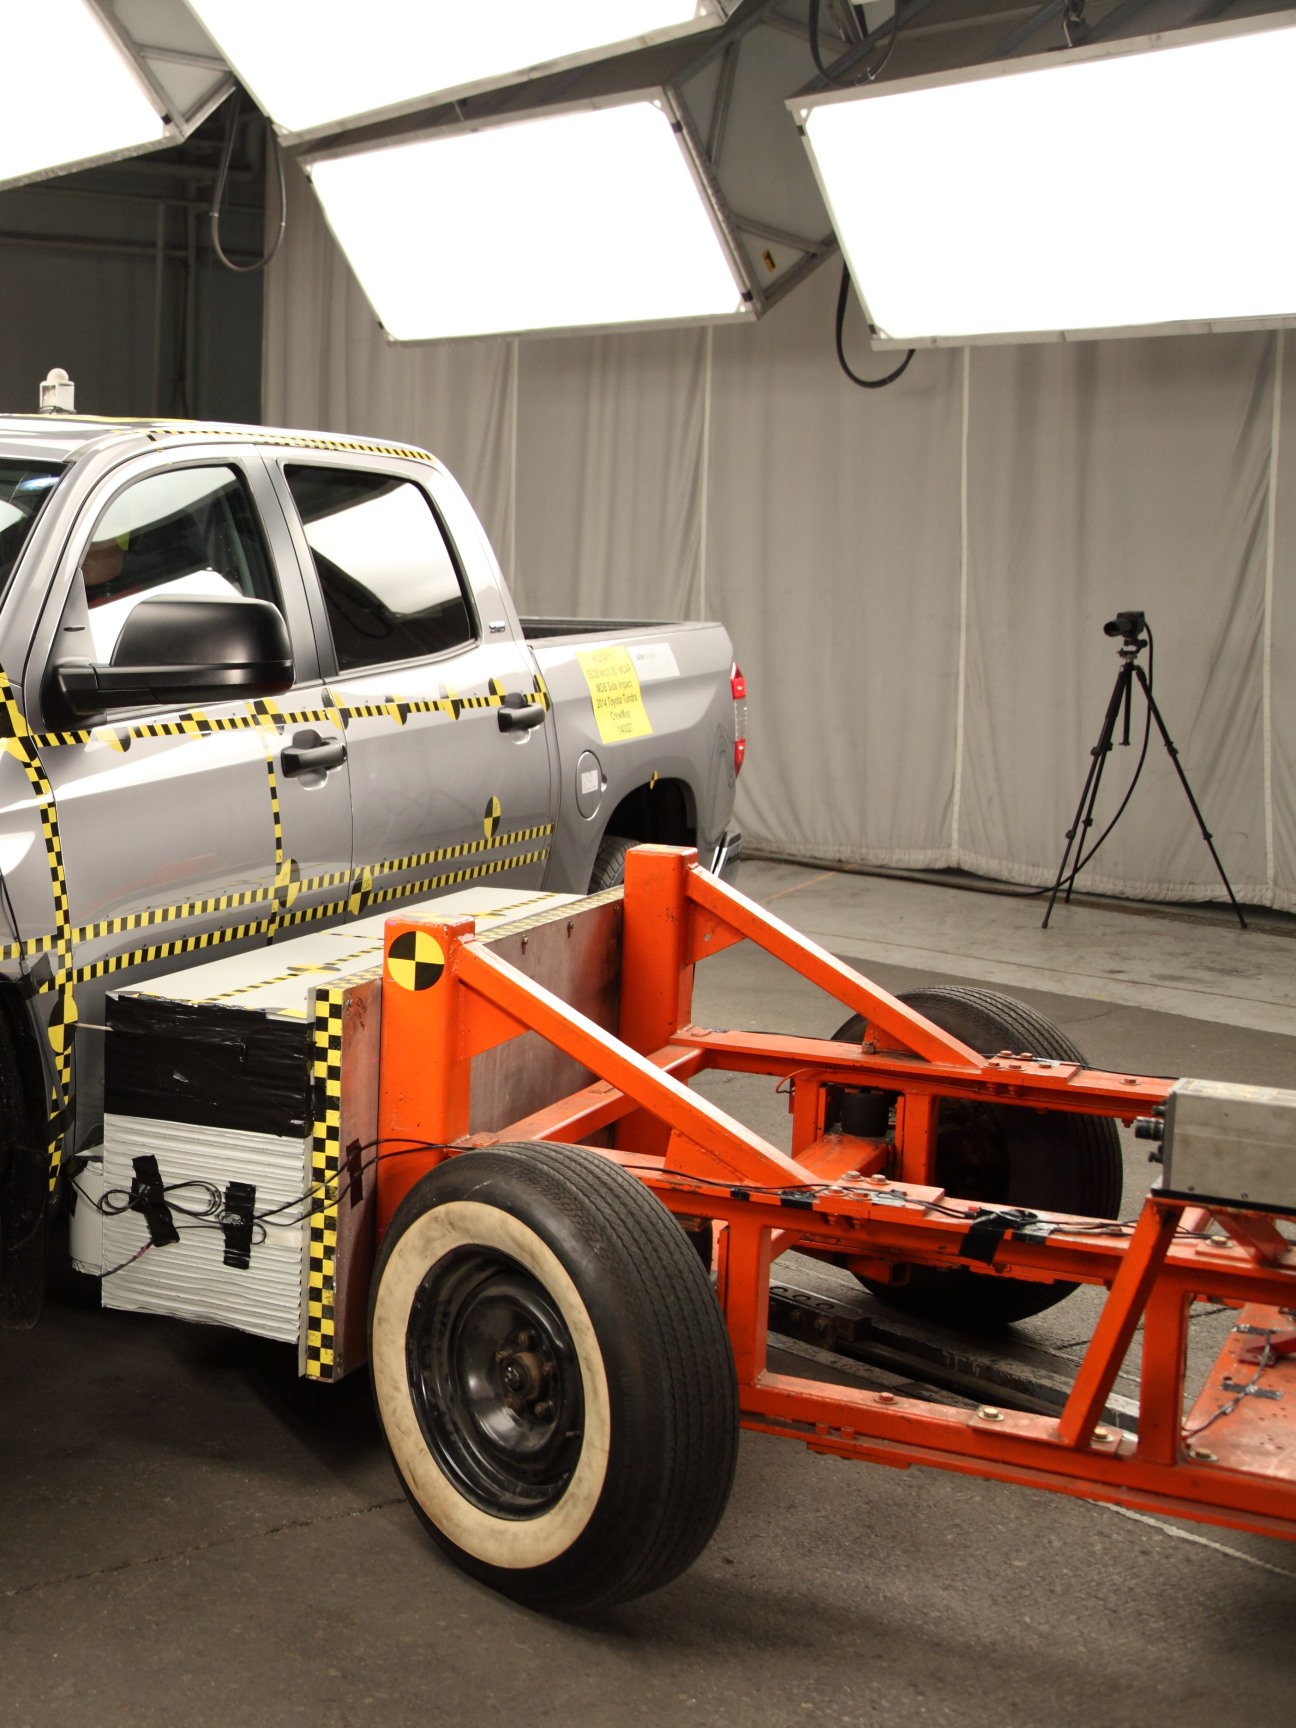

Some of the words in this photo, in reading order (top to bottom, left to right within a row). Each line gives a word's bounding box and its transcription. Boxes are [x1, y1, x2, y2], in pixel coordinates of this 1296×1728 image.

[596, 697, 607, 709] 2014
[607, 696, 622, 708] Toyota
[622, 693, 638, 704] Tundra
